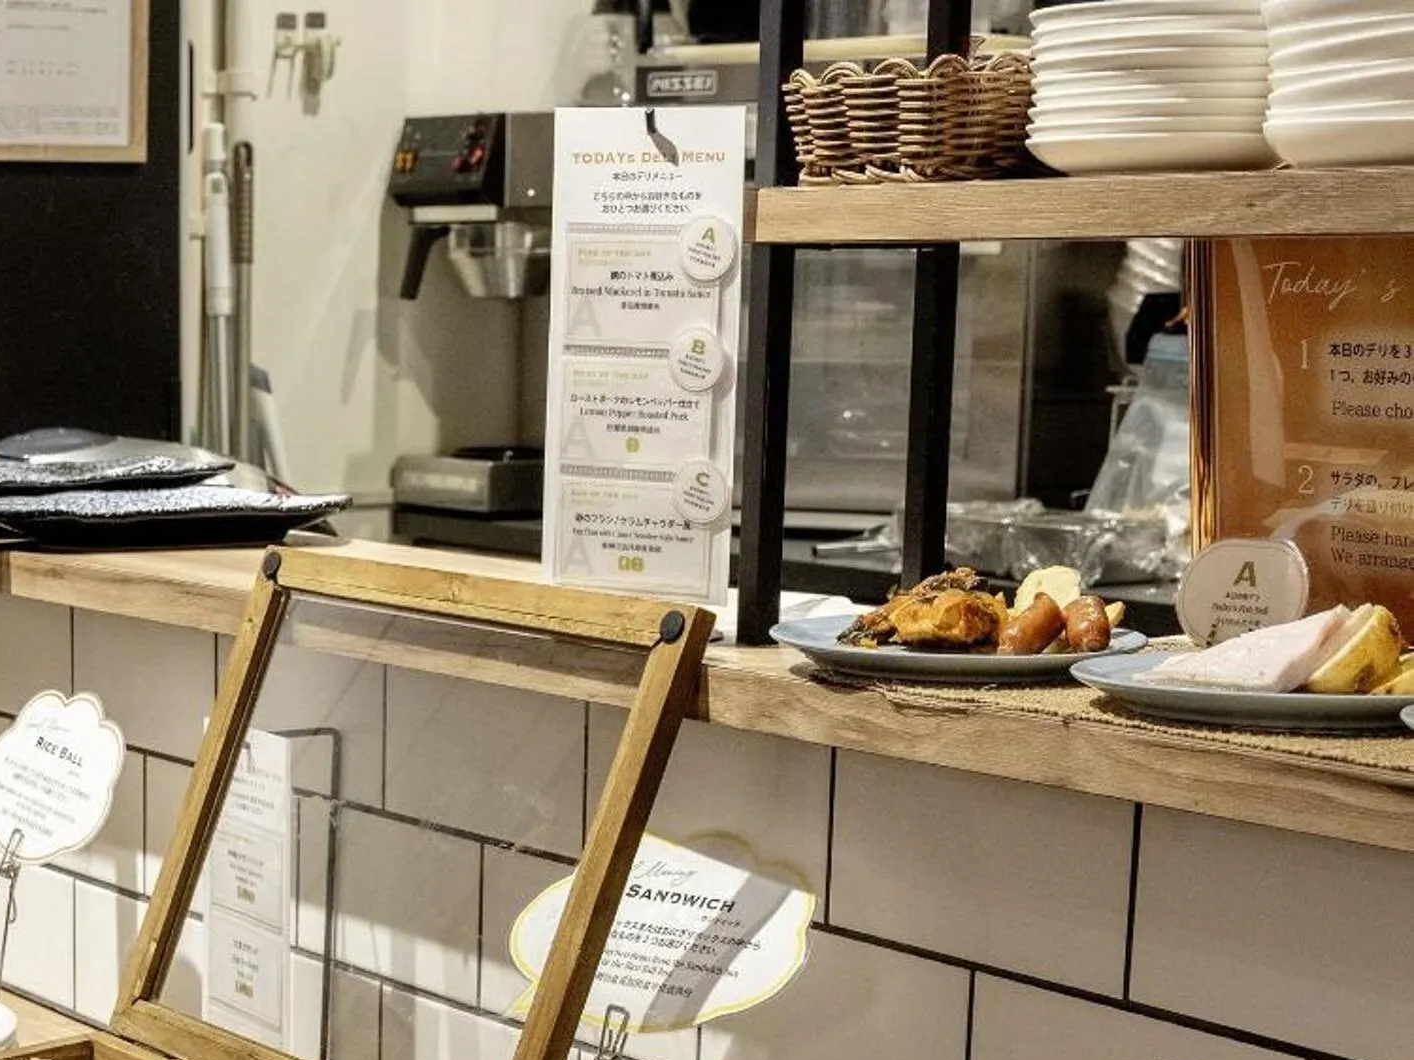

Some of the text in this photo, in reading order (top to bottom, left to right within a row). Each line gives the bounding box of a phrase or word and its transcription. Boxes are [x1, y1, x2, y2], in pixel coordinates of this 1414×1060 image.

[682, 151, 726, 164] MENU
[702, 227, 717, 244] A
[691, 338, 707, 355] B
[1330, 369, 1414, 386] 1つ、お好みの
[1332, 401, 1381, 418] Please
[696, 472, 711, 488] C
[1298, 465, 1315, 495] 2
[1331, 525, 1380, 545] Please
[1331, 547, 1353, 563] We
[1233, 561, 1256, 587] A
[35, 735, 83, 768] RICE BALL
[626, 883, 736, 913] SANDWICH
